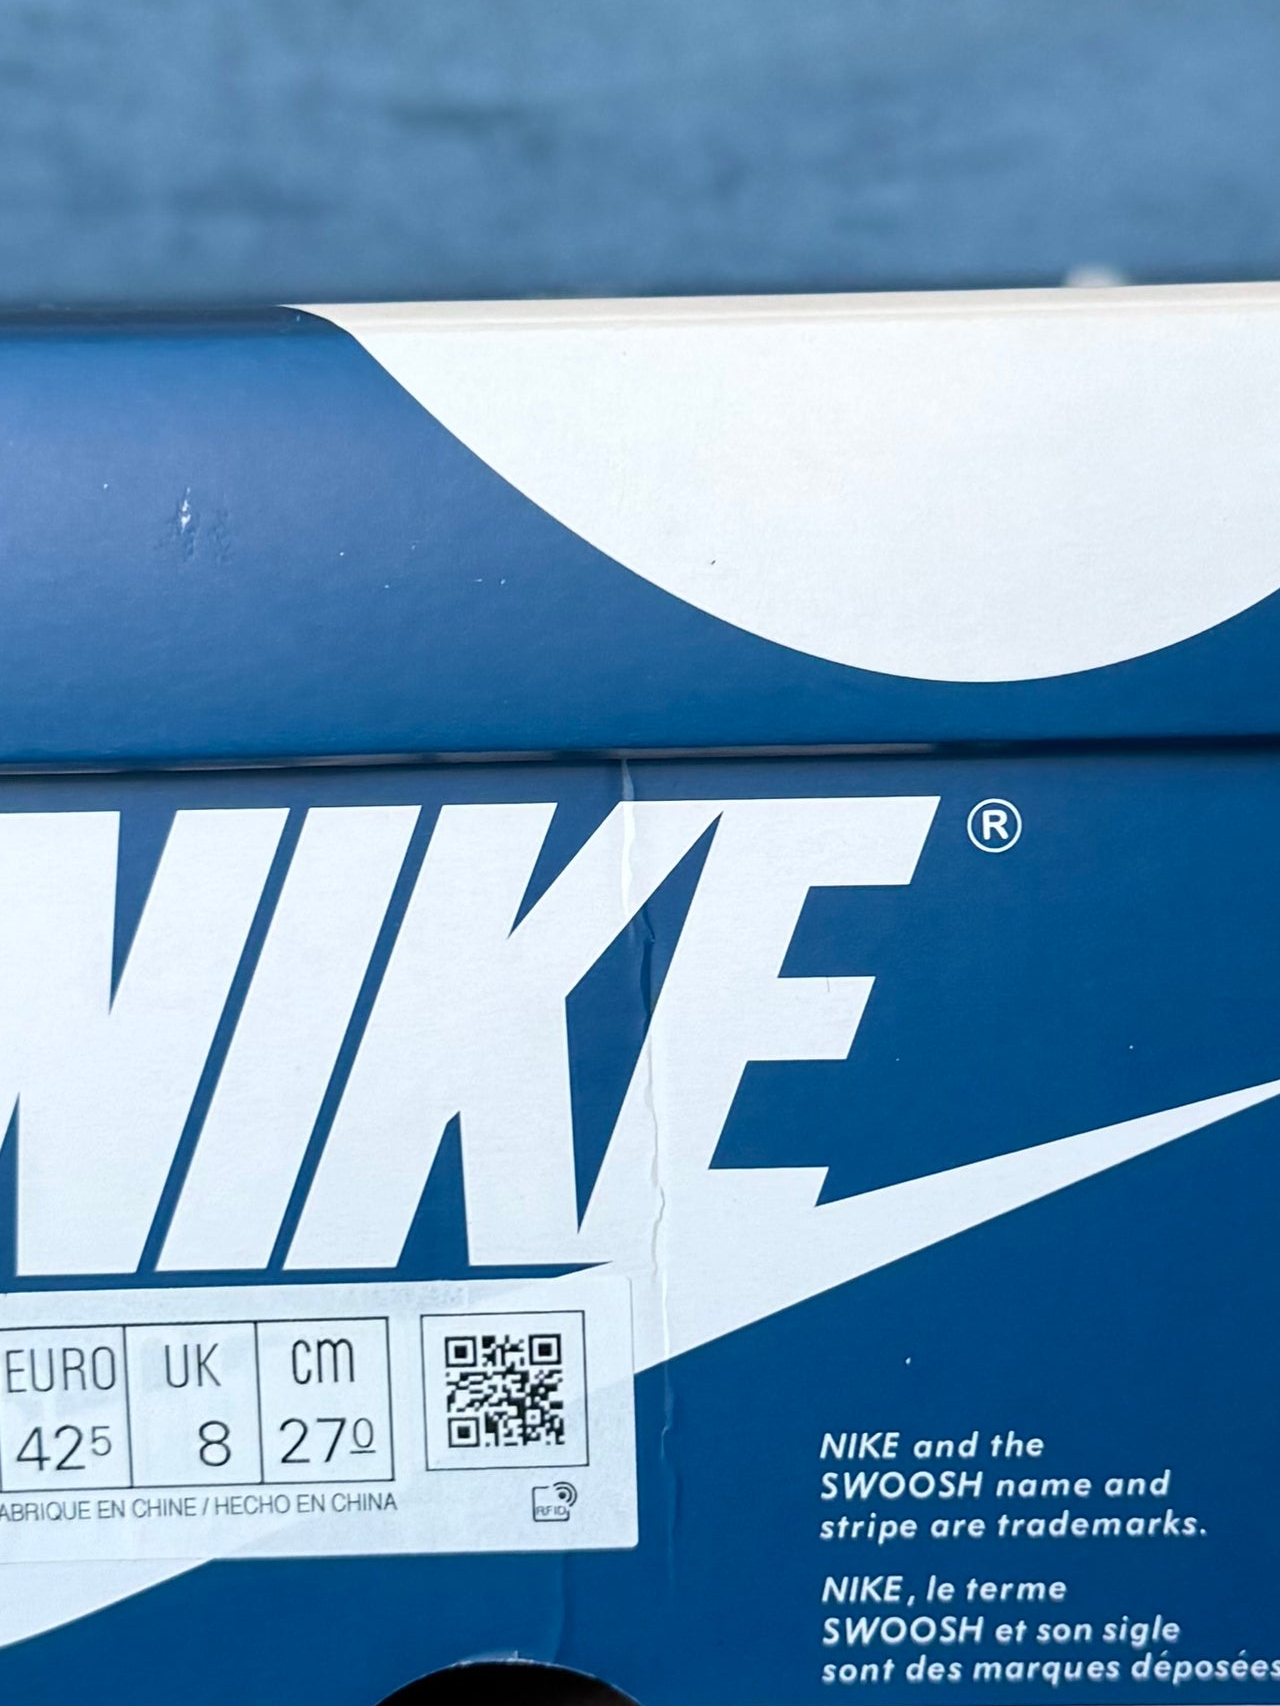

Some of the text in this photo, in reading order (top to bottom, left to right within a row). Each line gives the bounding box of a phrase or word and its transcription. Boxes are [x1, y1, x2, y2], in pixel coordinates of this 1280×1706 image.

[6, 1345, 117, 1394] EURO
[164, 1342, 220, 1389] UK
[290, 1336, 355, 1384] cm
[198, 1420, 232, 1467] 8
[820, 1431, 1045, 1459] NIKE and the
[820, 1470, 1171, 1501] SWOOSH name and
[98, 1500, 126, 1520] EN
[132, 1498, 197, 1519] CHINE
[200, 1498, 209, 1517] /
[215, 1495, 291, 1516] HECHO
[297, 1494, 325, 1514] EN
[330, 1492, 397, 1513] CHINA
[536, 1505, 566, 1515] RFID
[820, 1509, 1207, 1544] stripe are trademarks.
[822, 1575, 1067, 1607] NIKE, le terme
[822, 1614, 1181, 1649] SWOOSH et son sigle
[822, 1658, 895, 1683] sont
[906, 1655, 962, 1682] des
[973, 1659, 1120, 1687] marques
